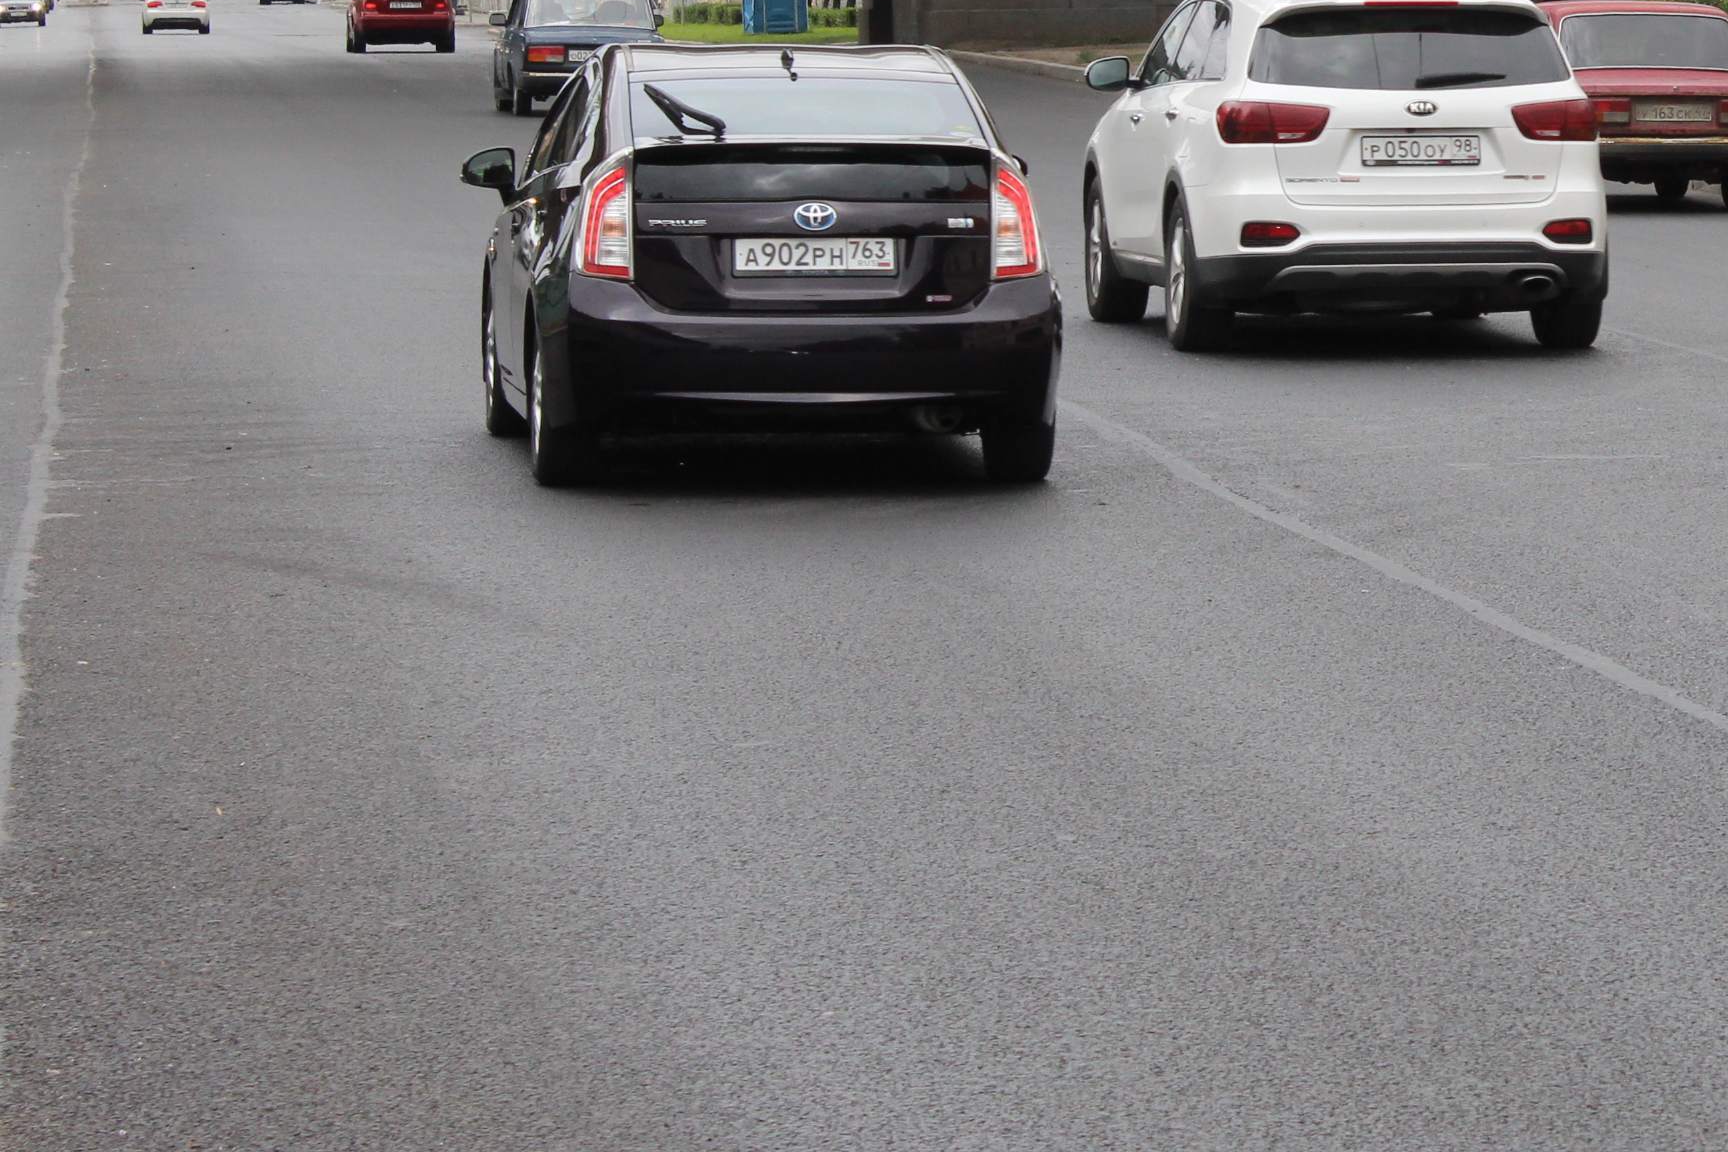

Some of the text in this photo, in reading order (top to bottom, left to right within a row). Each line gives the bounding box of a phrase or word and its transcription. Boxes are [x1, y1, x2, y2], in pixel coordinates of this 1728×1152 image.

[1408, 102, 1435, 113] KIA
[1453, 139, 1473, 153] 98
[849, 241, 887, 259] 763
